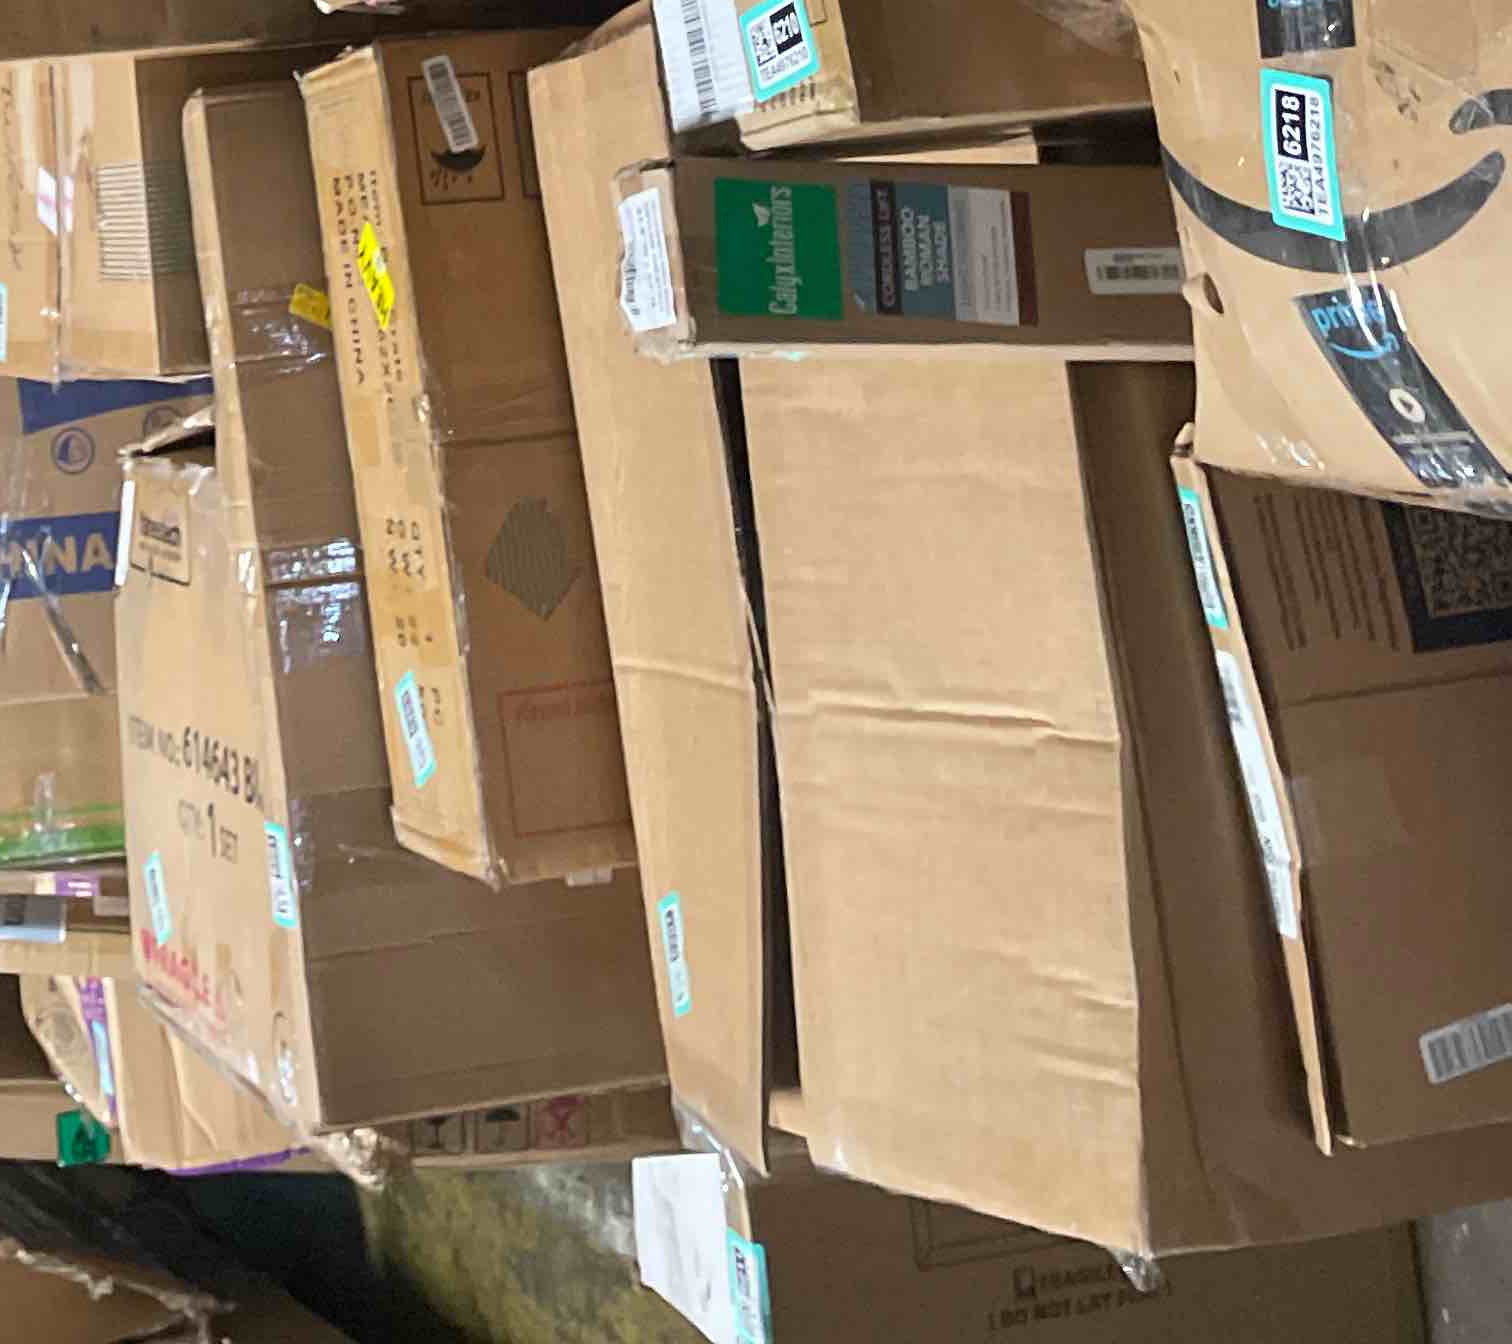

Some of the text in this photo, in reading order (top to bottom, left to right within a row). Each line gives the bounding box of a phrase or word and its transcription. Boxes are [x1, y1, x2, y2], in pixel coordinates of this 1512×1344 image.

[1280, 95, 1302, 155] 6218
[1308, 95, 1329, 215] TEA4976218
[332, 177, 366, 385] MADE IN CHINA
[764, 185, 803, 315] CalyxInteriors
[877, 225, 896, 307] CORDLESS
[900, 207, 919, 291] BAMBOO
[918, 215, 933, 286] ROMAN
[933, 221, 950, 283] SHADE
